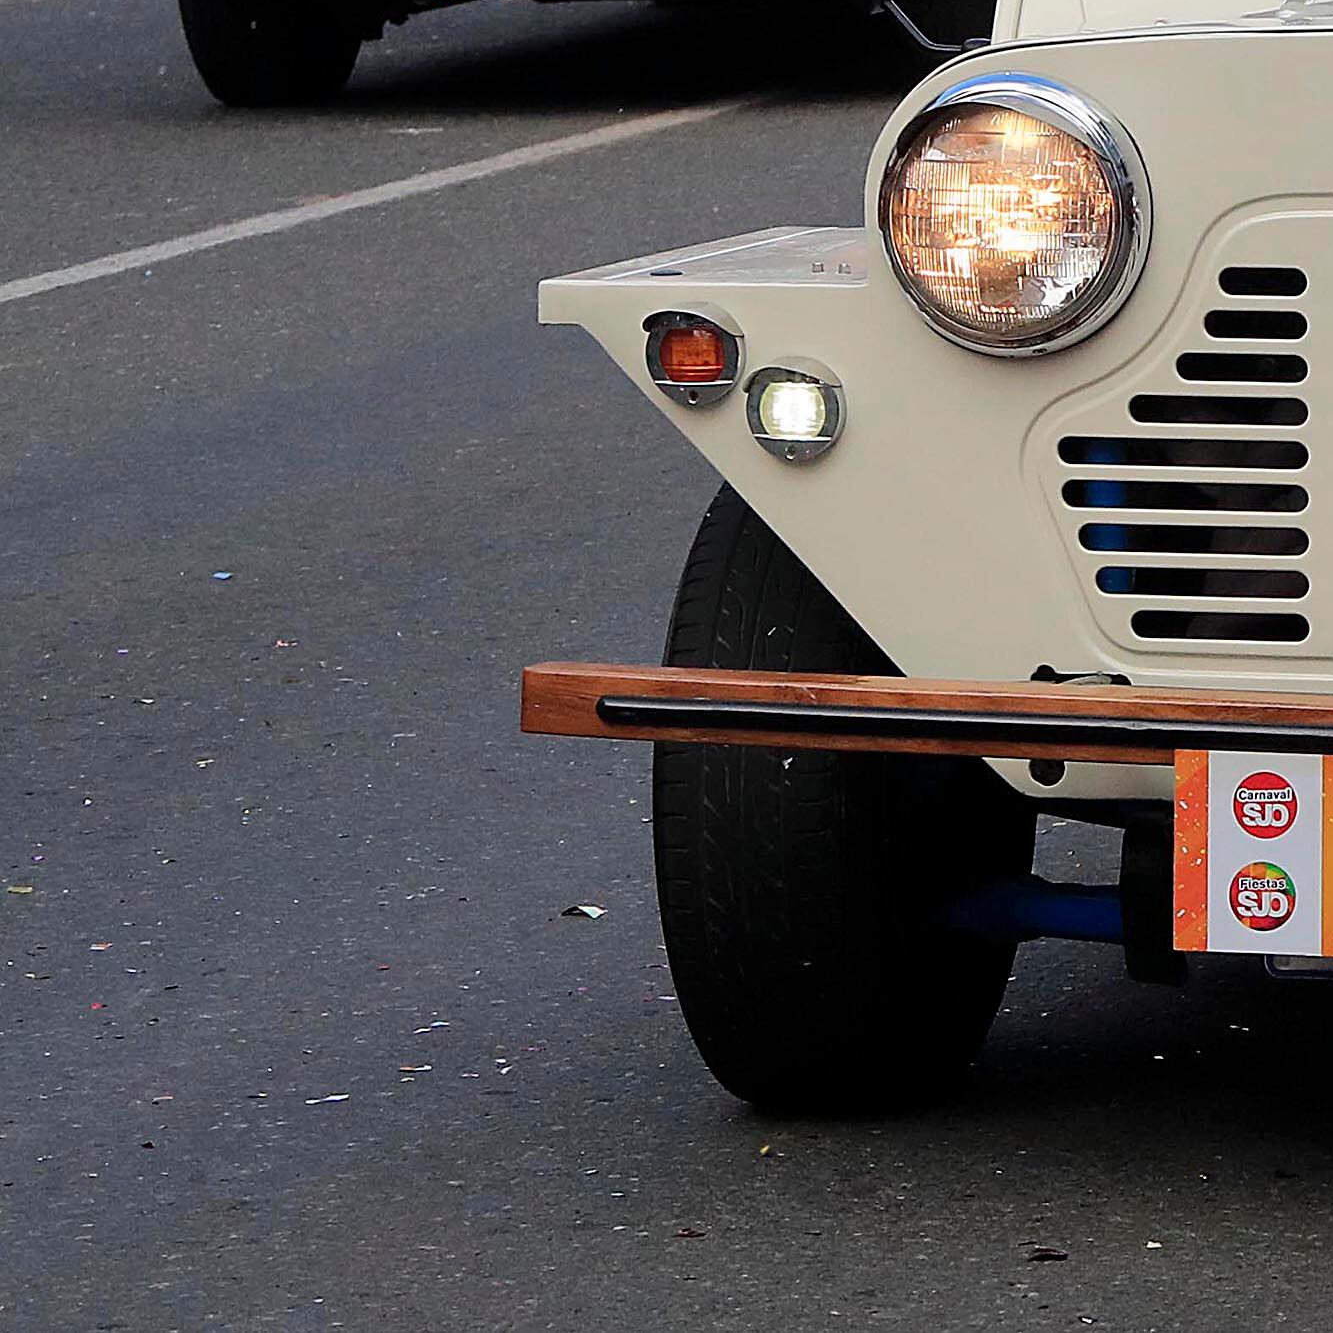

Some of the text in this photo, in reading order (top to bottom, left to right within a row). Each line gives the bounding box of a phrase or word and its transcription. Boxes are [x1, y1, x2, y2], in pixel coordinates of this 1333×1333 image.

[1238, 789, 1292, 801] Carnaval
[1242, 803, 1290, 827] SJO
[1240, 878, 1286, 890] Fiestas
[1237, 891, 1290, 918] SJO
